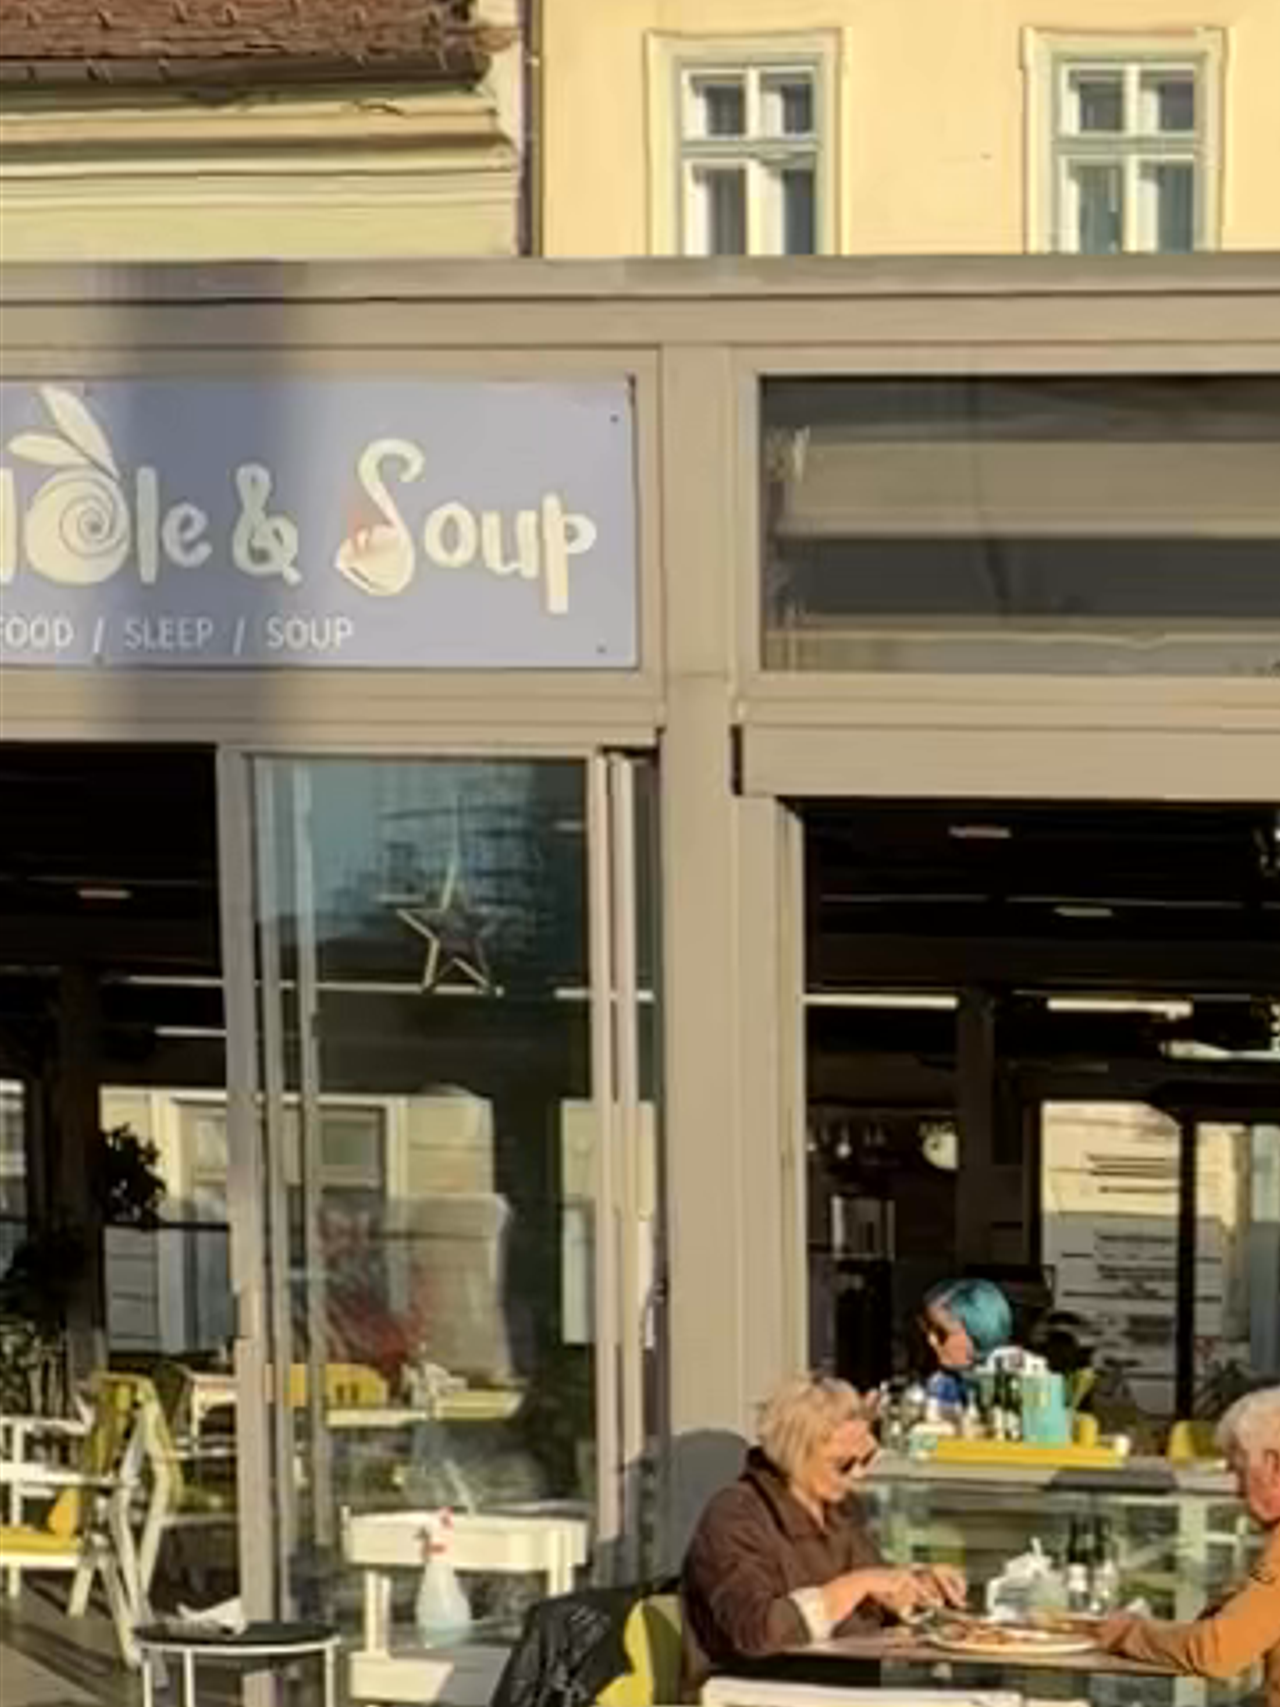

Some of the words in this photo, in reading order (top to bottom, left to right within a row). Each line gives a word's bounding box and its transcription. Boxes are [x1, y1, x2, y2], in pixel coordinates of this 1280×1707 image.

[232, 462, 301, 584] &
[335, 438, 597, 614] Soup
[0, 616, 74, 648] OOD
[124, 616, 214, 650] SLEEP
[266, 615, 356, 649] SOUP
